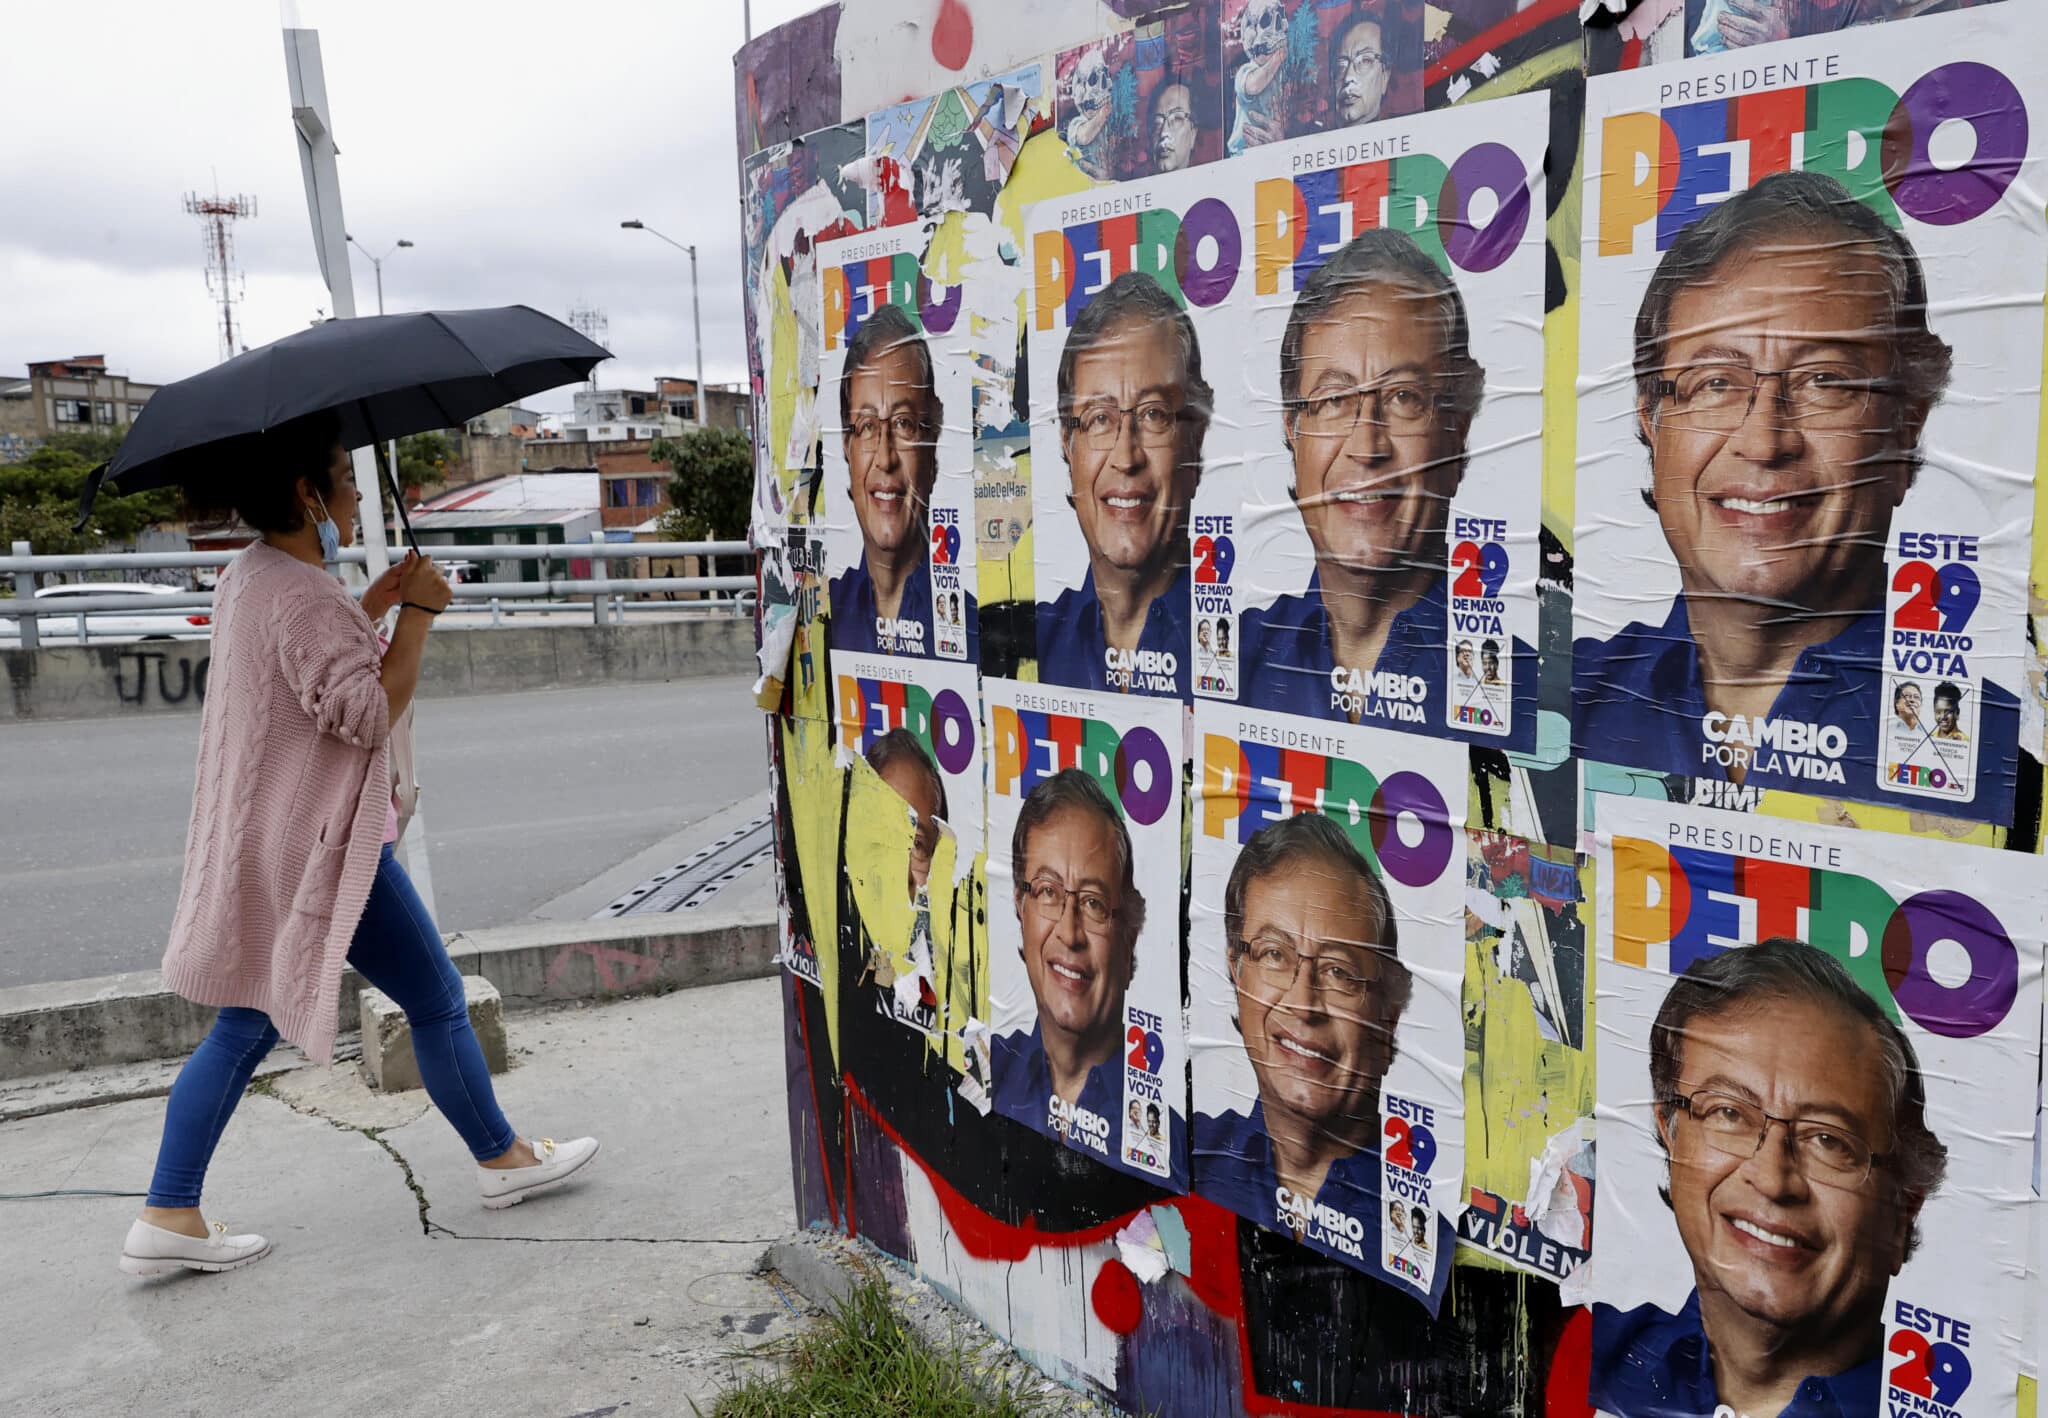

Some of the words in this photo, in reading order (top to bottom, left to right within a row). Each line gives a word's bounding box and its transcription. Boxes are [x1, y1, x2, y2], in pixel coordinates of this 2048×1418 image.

[1660, 55, 1841, 104] PRESIDENTE
[1293, 135, 1411, 171] PRESIDENTE
[1598, 61, 2029, 257] PETRO
[1062, 192, 1153, 224] PRESIDENTE
[1255, 142, 1531, 296] PETRO
[841, 239, 902, 260] PRESIDENTE
[1033, 197, 1242, 331] PETRO
[932, 508, 958, 524] ESTE
[1194, 516, 1233, 535] ESTE
[1455, 518, 1506, 541] ESTE
[932, 524, 961, 564] 29
[1898, 532, 1980, 562] ESTE
[933, 565, 942, 573] DE
[942, 565, 960, 576] MAYO
[1193, 535, 1235, 584] 29
[1451, 540, 1510, 599] 29
[934, 575, 960, 590] VOTA
[1194, 584, 1206, 595] DE
[1207, 585, 1233, 597] MAYO
[1892, 560, 1982, 633] 29
[1195, 597, 1233, 614] VOTA
[1453, 598, 1469, 610] DE
[1470, 599, 1505, 614] MAYO
[876, 617, 925, 640] CAMBIO
[1453, 613, 1504, 635] VOTA
[905, 640, 926, 655] VIDA
[1892, 630, 1918, 647] DE
[1920, 632, 1973, 651] MAYO
[855, 663, 913, 682] PRESIDENTE
[1105, 647, 1177, 675] CAMBIO
[1892, 649, 1969, 678] VOTA
[1146, 675, 1177, 693] VIDA
[1330, 666, 1427, 703] CAMBIO
[1015, 694, 1095, 717] PRESIDENTE
[1386, 702, 1427, 724] VIDA
[838, 674, 975, 775] PETRO
[1239, 722, 1346, 756] PRESIDENTE
[1702, 711, 1848, 759] CAMBIO
[992, 705, 1173, 825] PETRO
[1786, 755, 1846, 785] VIDA
[1888, 761, 1947, 789] PETRO
[1203, 732, 1454, 888] PETRO
[1668, 822, 1842, 868] PRESIDENTE
[1612, 835, 2019, 1039] PETRO
[1128, 1006, 1163, 1033] ESTE
[1127, 1025, 1165, 1075] 29
[1128, 1067, 1138, 1078] DE
[1139, 1071, 1163, 1087] MAYO
[1128, 1077, 1162, 1103] VOTA
[1049, 1094, 1110, 1139] CAMBIO
[1386, 1094, 1435, 1128] ESTE
[1082, 1130, 1108, 1156] VIDA
[1384, 1116, 1437, 1175] 29
[1385, 1162, 1400, 1177] DE
[1401, 1168, 1432, 1190] MAYO
[1386, 1174, 1431, 1208] VOTA
[1275, 1187, 1364, 1242] CAMBIO
[1326, 1231, 1364, 1261] VIDA
[1895, 1299, 1971, 1348] ESTE
[1888, 1329, 1972, 1408] 29
[1888, 1386, 1911, 1407] DE
